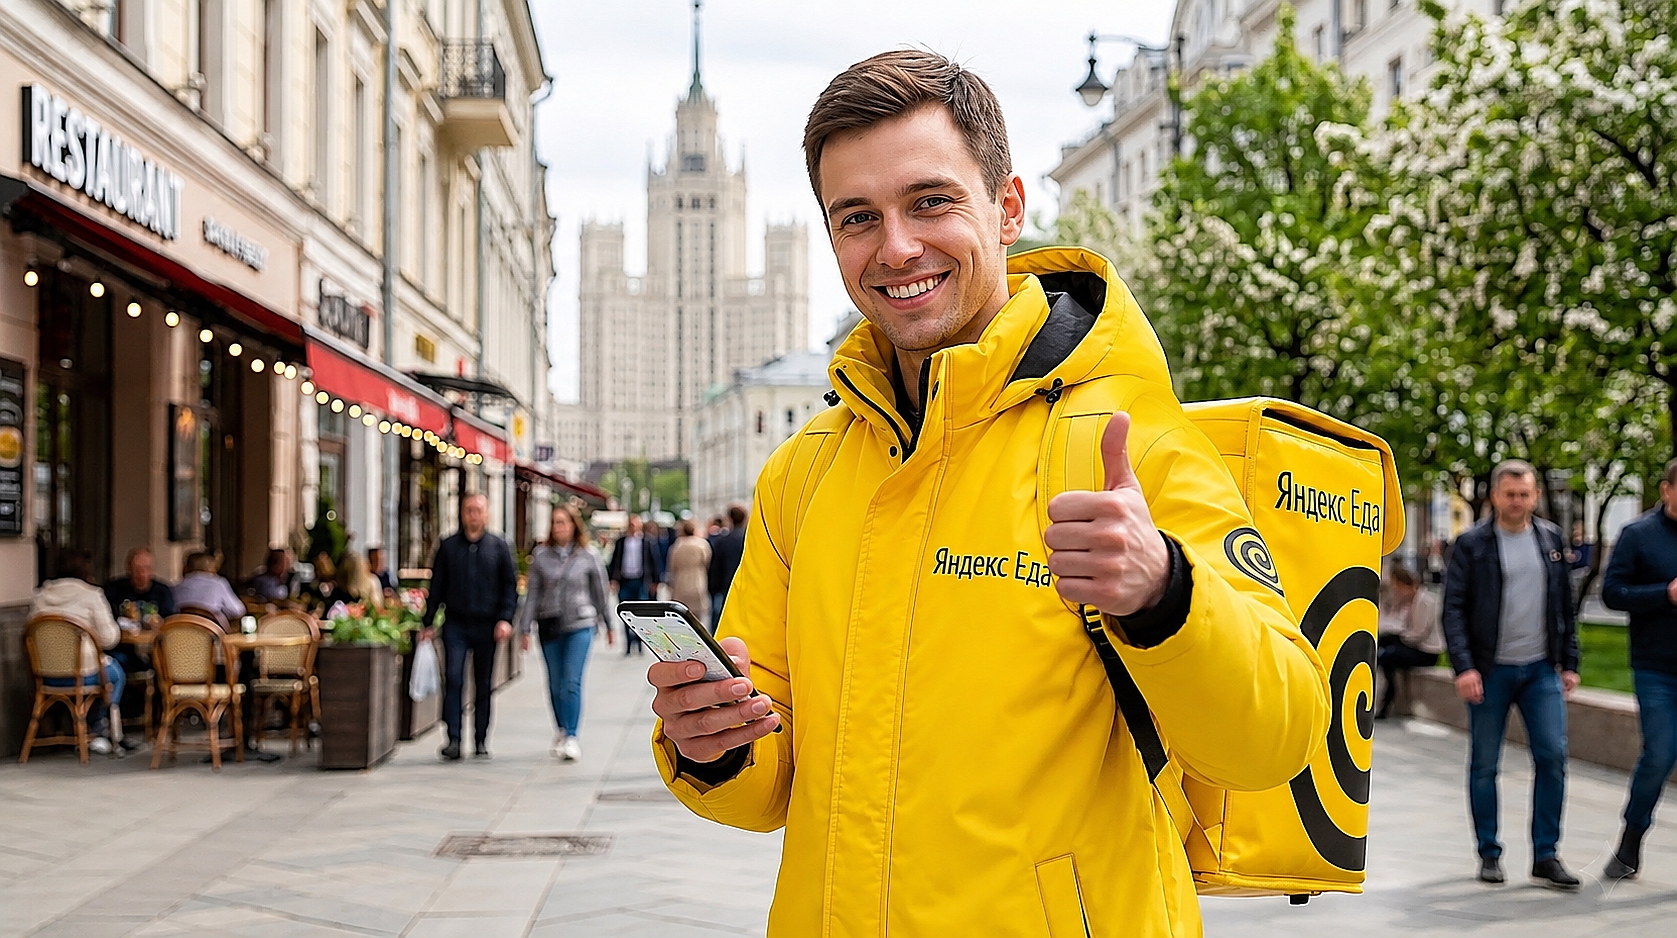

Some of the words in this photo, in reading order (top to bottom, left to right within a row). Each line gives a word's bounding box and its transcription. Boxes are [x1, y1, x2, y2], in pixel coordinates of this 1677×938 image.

[31, 83, 185, 239] RESTAURANT
[1274, 471, 1347, 524] Яндекс
[1351, 488, 1380, 536] Еда
[932, 547, 1009, 580] Яндекс
[1014, 550, 1052, 588] Еда
